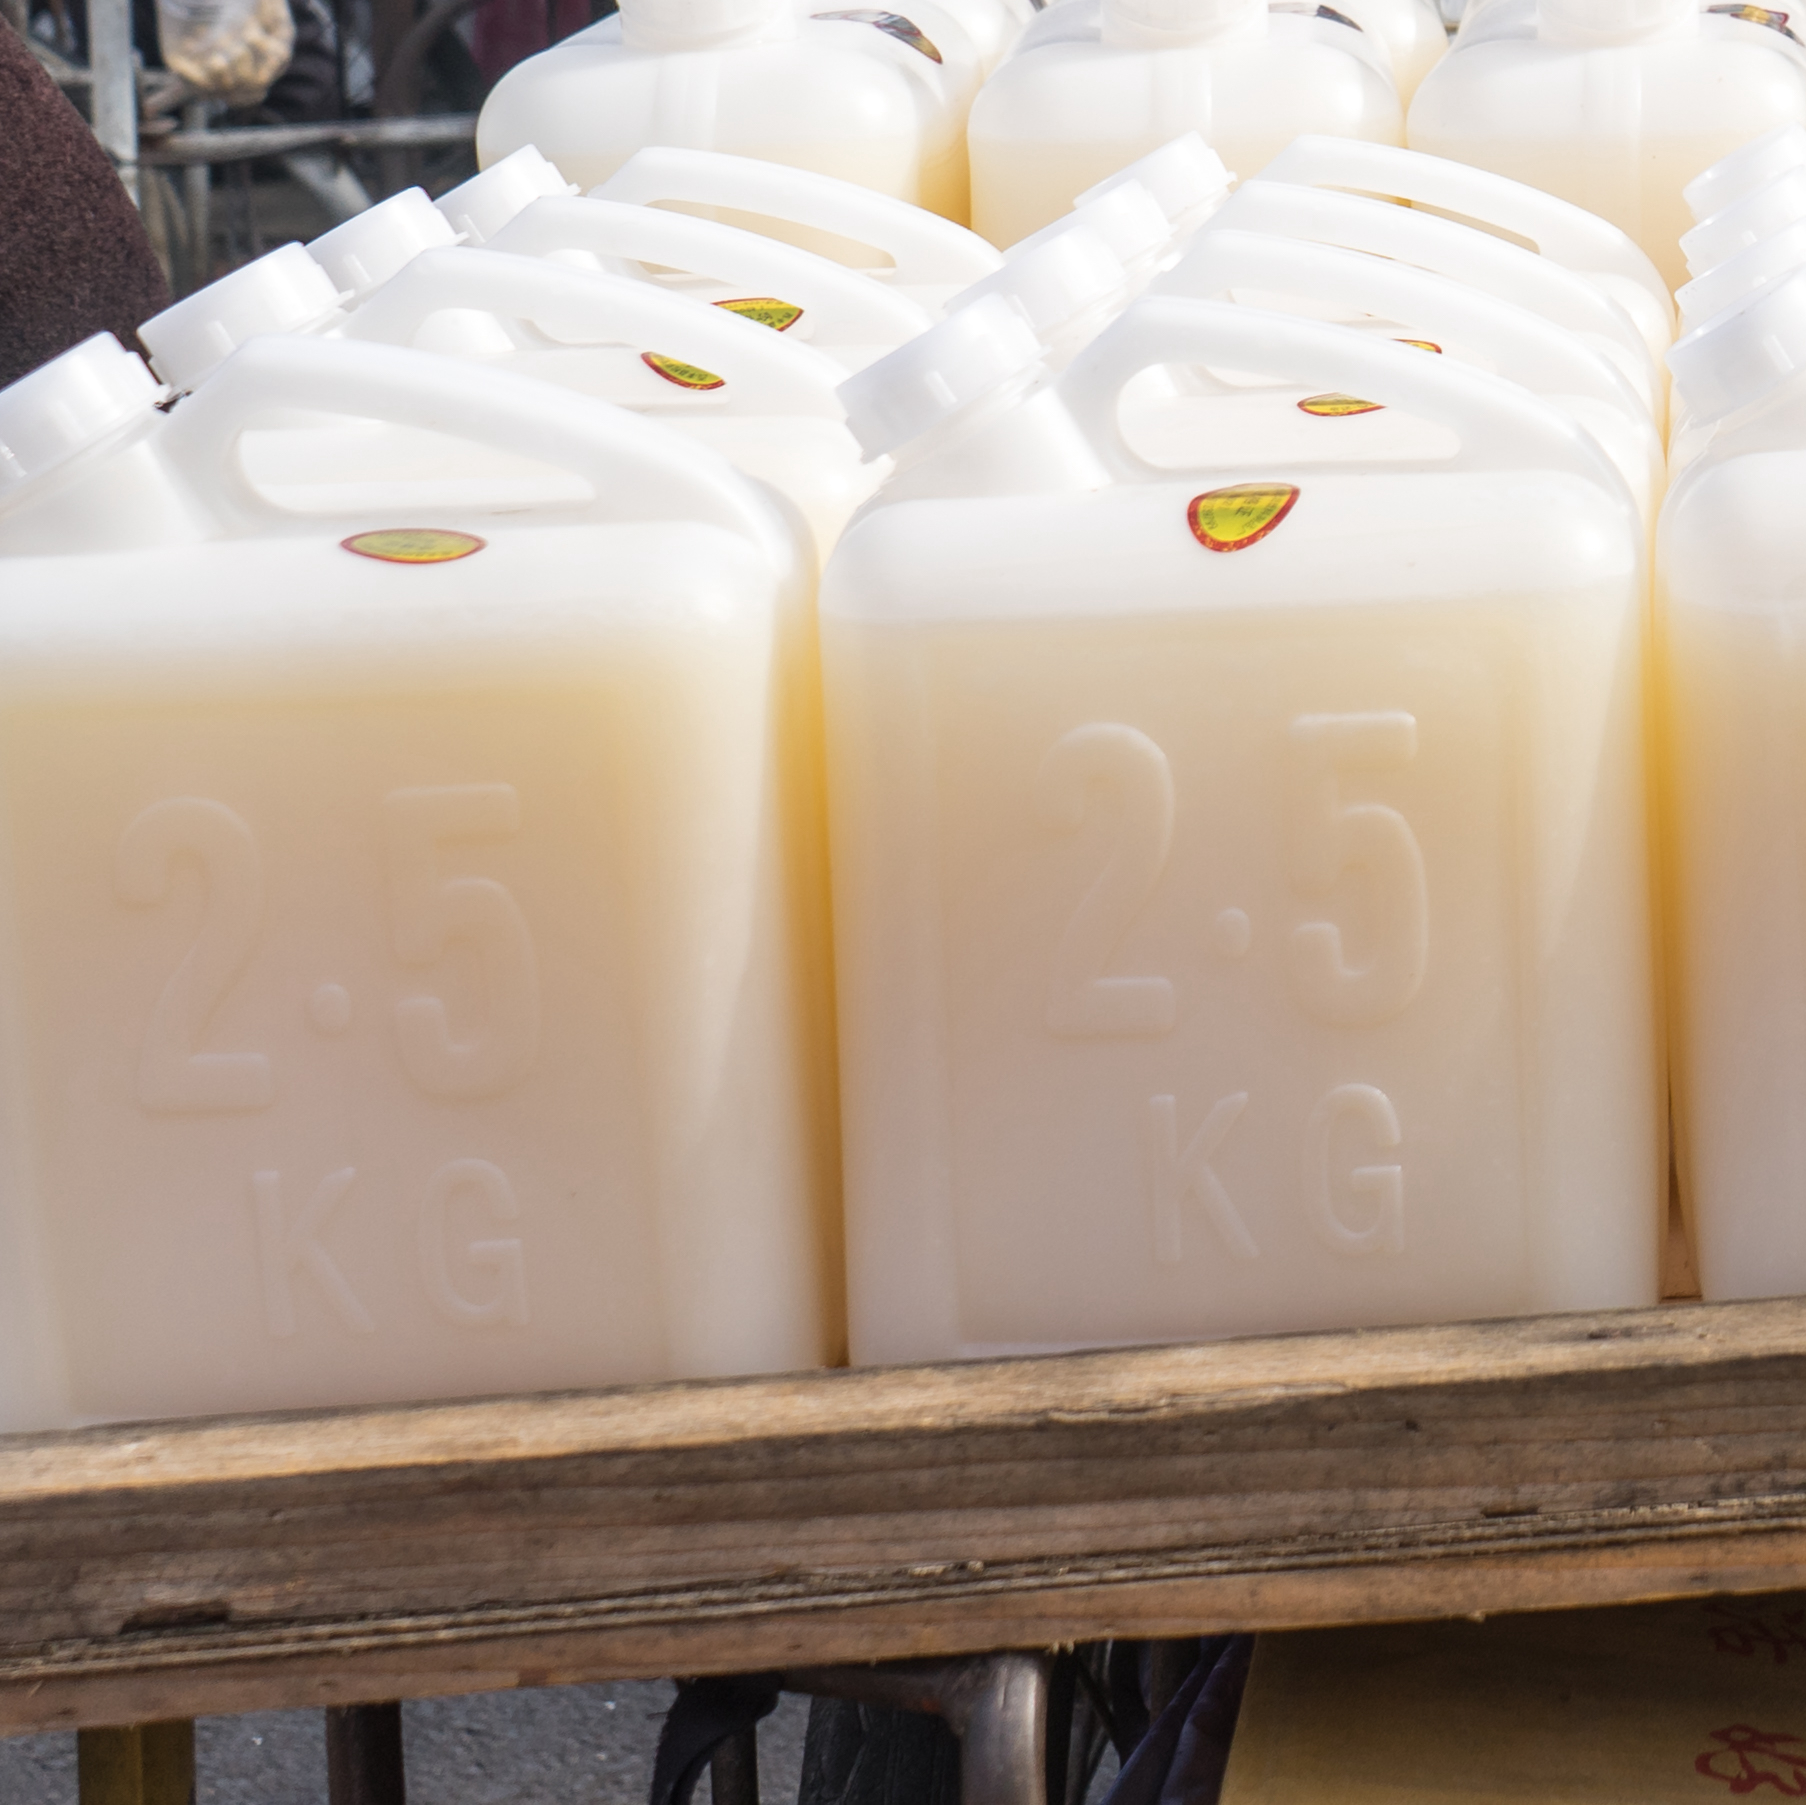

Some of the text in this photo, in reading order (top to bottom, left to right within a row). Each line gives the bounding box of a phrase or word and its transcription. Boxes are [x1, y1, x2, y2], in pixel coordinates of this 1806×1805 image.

[111, 780, 540, 1116] 2.5
[1034, 709, 1430, 1037] 2.5
[250, 1156, 532, 1339] KG
[1147, 1082, 1407, 1264] KG
